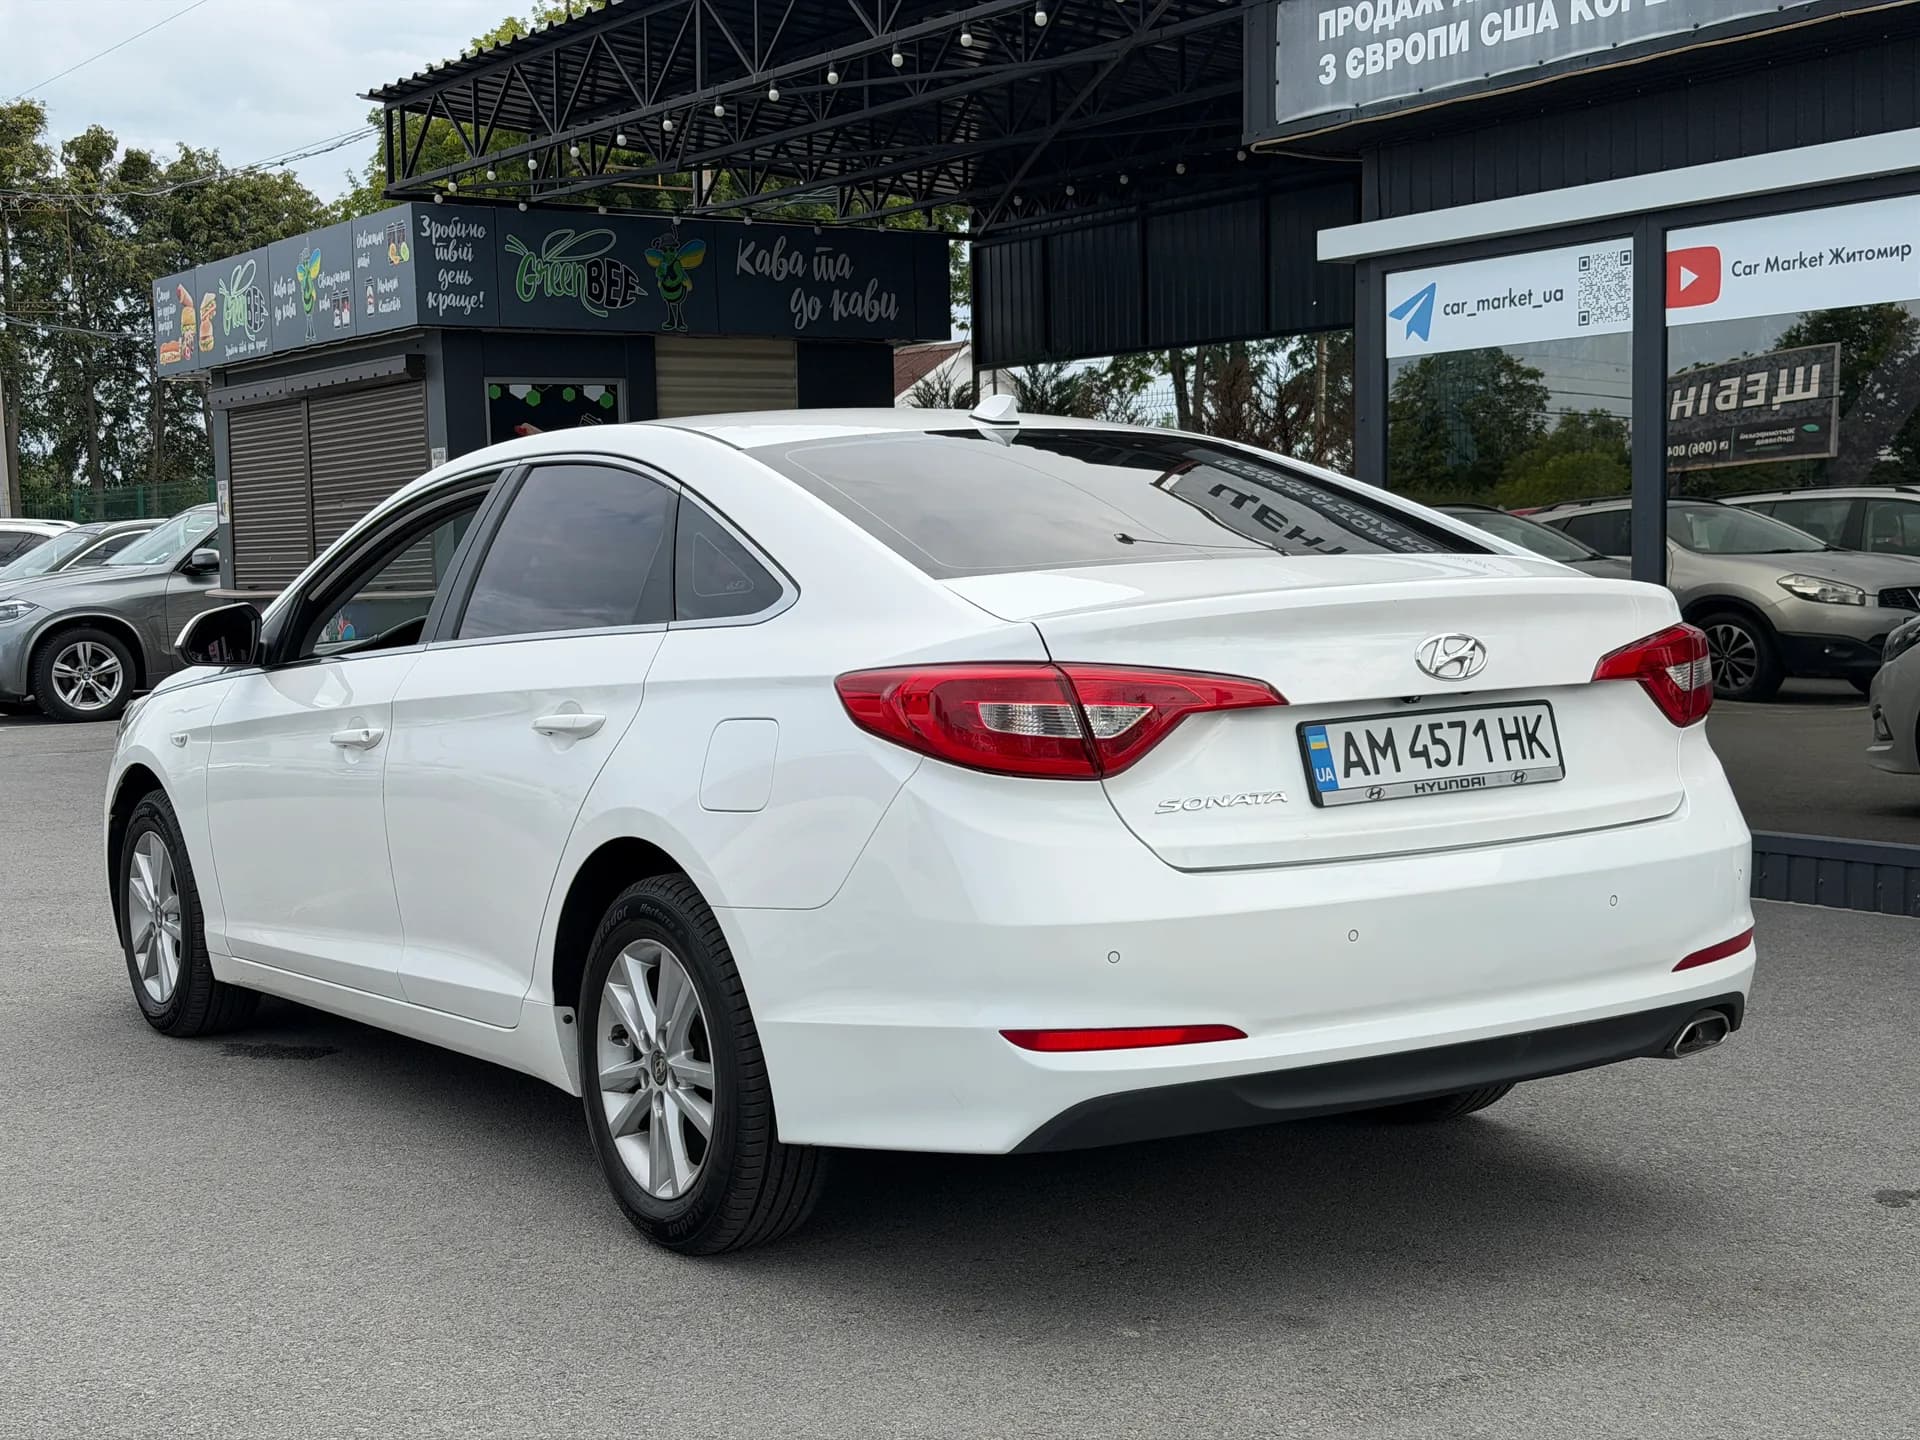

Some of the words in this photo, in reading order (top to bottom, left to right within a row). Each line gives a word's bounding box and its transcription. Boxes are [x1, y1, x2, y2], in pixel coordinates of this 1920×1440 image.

[1318, 53, 1337, 86] З
[1345, 20, 1470, 79] ЄВРОПИ
[1480, 0, 1560, 46] США
[420, 215, 487, 245] Зробимо
[435, 241, 474, 263] твій
[737, 235, 807, 281] Кава
[812, 247, 854, 281] та
[1731, 260, 1760, 278] Car
[1764, 251, 1824, 275] Market
[1828, 242, 1912, 267] Житомир
[438, 268, 473, 291] день
[428, 291, 485, 317] краще!
[790, 287, 823, 330] до
[830, 278, 900, 323] кави
[1443, 287, 1564, 317] car_market_ua
[1344, 727, 1401, 778] AM
[1409, 718, 1494, 769] 4571
[1498, 714, 1552, 761] HK
[1315, 767, 1335, 783] UA
[1414, 776, 1486, 794] HYUNDAI
[1154, 791, 1288, 814] SONATA
